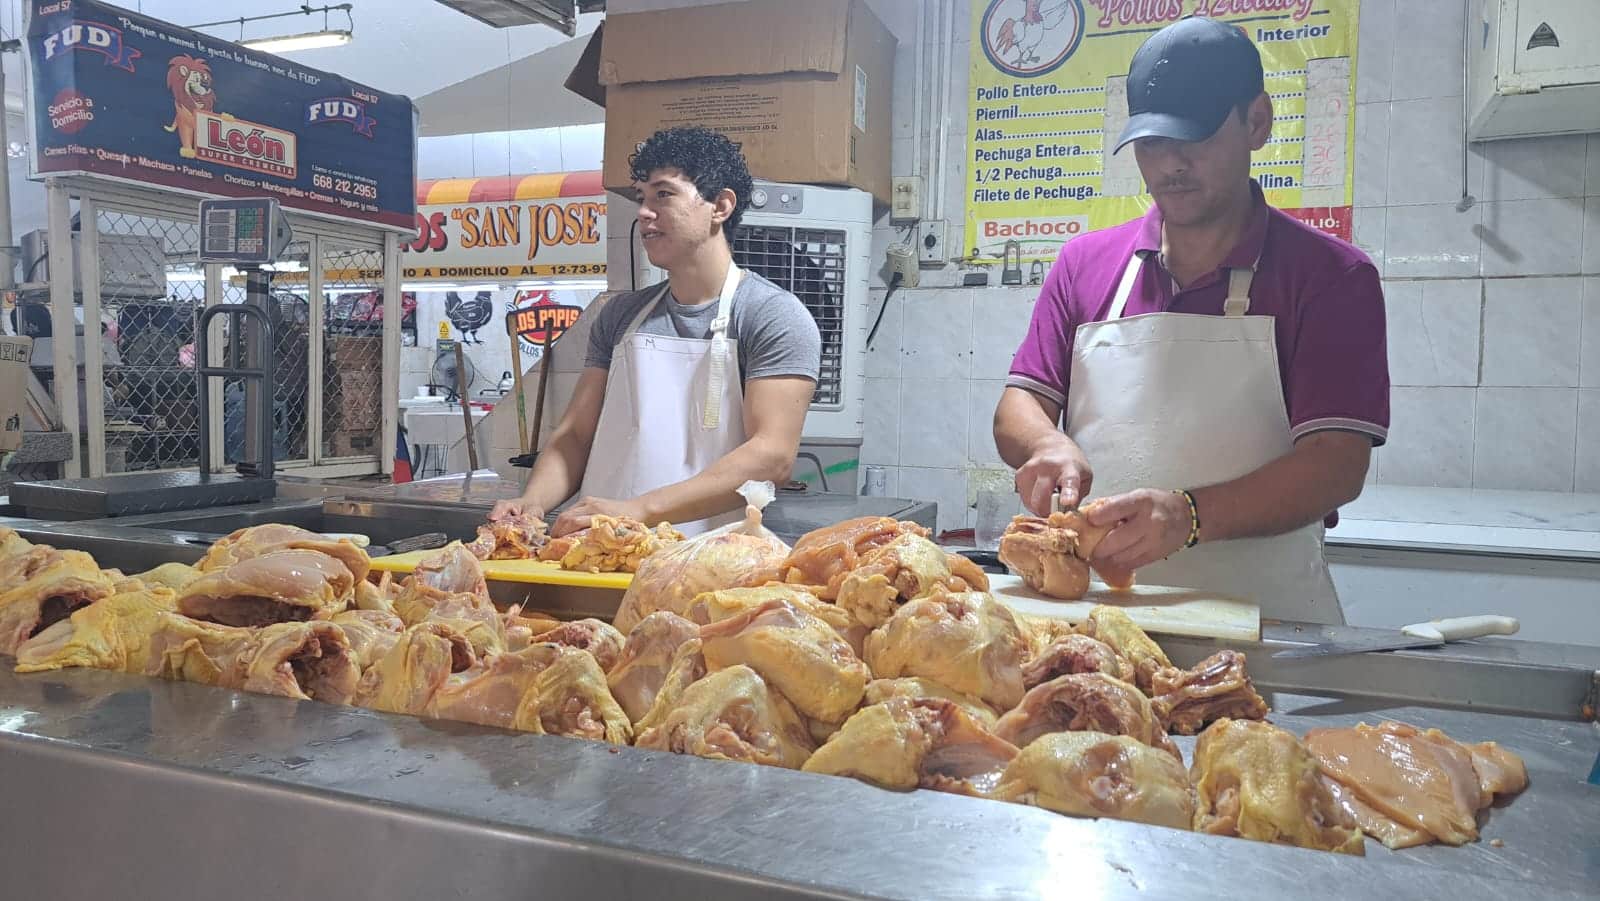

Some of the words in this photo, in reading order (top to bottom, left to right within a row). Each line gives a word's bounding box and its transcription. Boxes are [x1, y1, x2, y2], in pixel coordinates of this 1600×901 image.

[40, 3, 60, 15] Local
[44, 24, 112, 60] FUD
[1256, 24, 1330, 42] Interior
[976, 86, 1010, 101] Pollo
[48, 97, 84, 116] Servicio
[86, 98, 93, 107] a
[309, 101, 358, 121] FUD
[52, 111, 94, 129] Domicilio
[208, 118, 285, 164] León
[975, 147, 1032, 162] Pechuga
[139, 156, 176, 172] Machaca
[182, 166, 213, 179] Panelas
[223, 174, 256, 188] Chorizos
[975, 167, 1001, 184] 1/2
[1259, 173, 1293, 189] llina
[313, 174, 333, 190] 668
[335, 178, 352, 194] 212
[353, 182, 378, 199] 2953
[974, 188, 1010, 203] Filete
[1014, 187, 1030, 201] de
[1034, 184, 1094, 200] Pechuga
[984, 220, 1081, 237] Bachoco
[424, 268, 433, 277] A
[439, 266, 509, 277] DOMICILIO
[520, 265, 538, 275] AL
